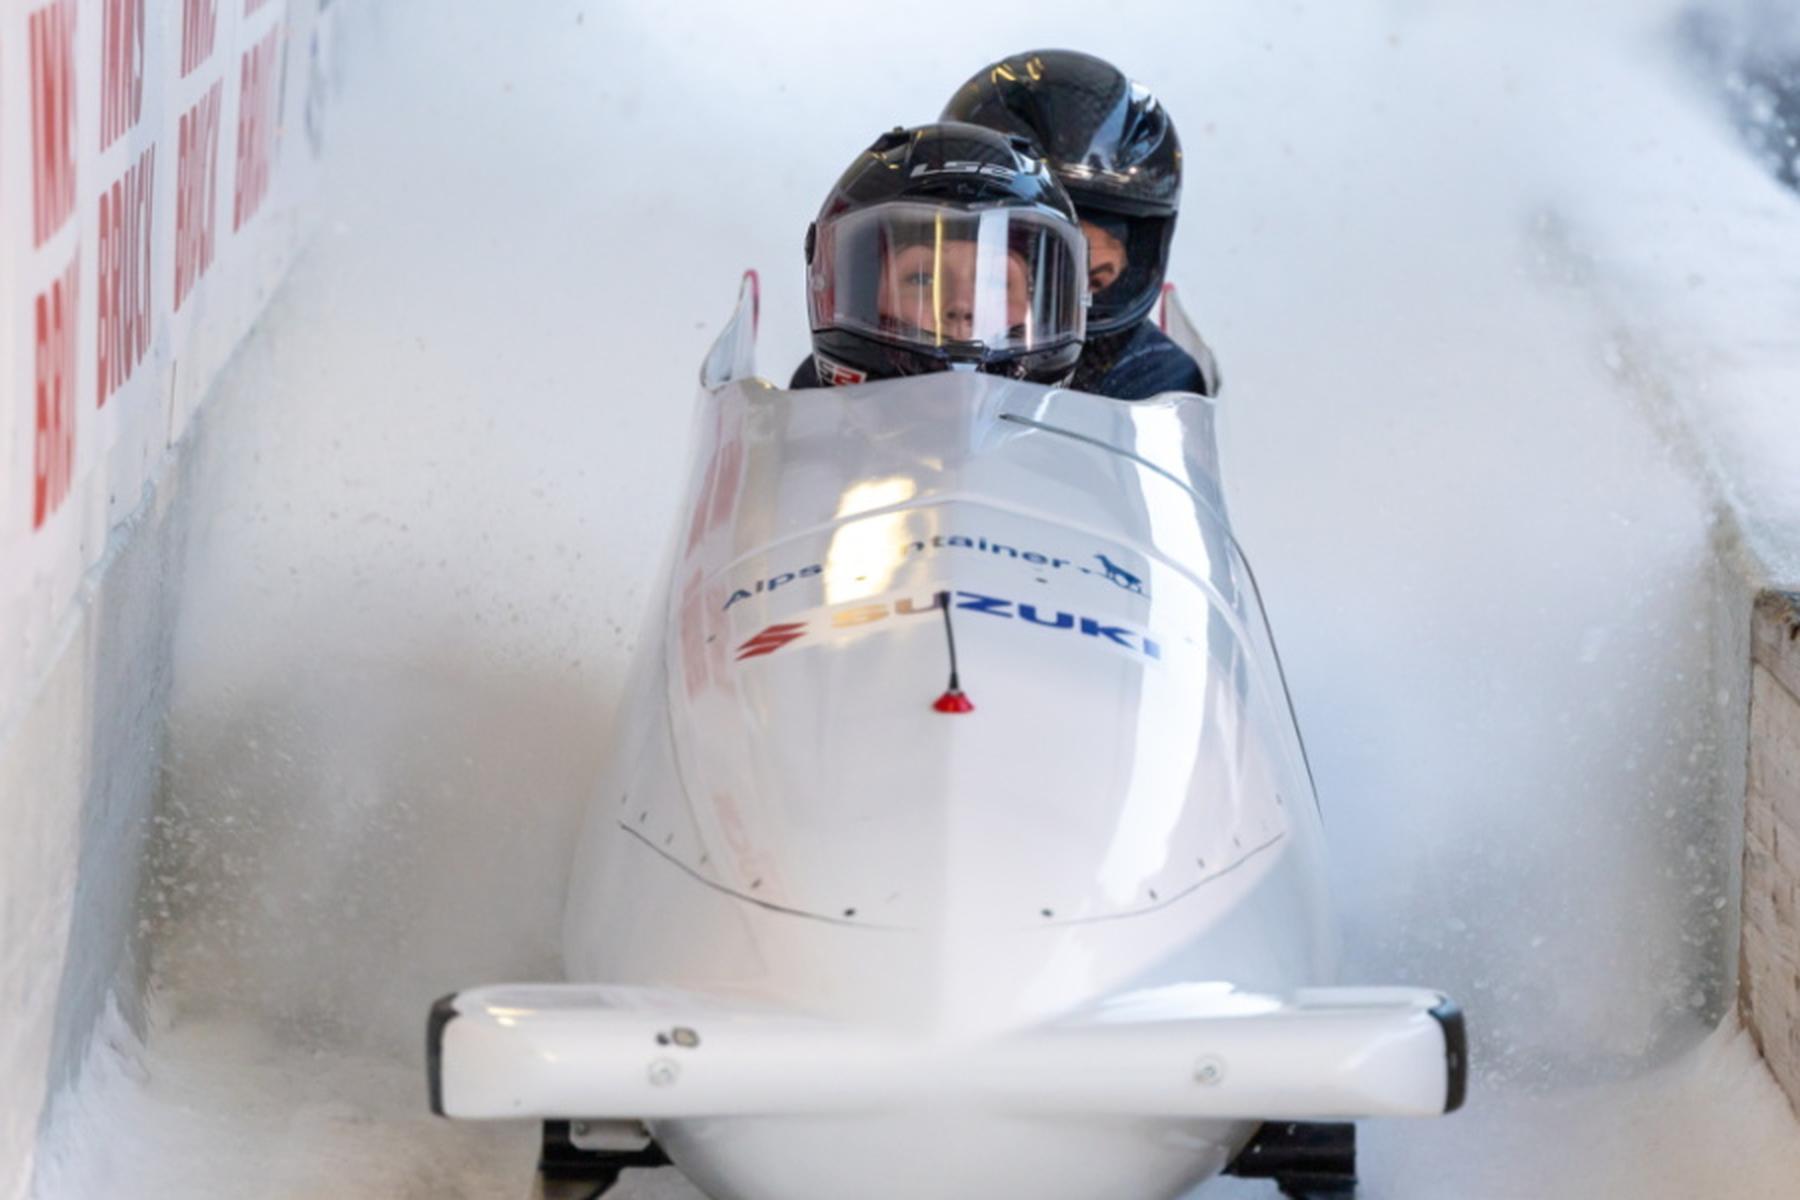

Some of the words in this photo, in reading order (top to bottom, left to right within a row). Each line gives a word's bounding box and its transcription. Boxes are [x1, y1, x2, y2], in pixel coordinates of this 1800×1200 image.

[96, 140, 156, 411] BRUCK
[722, 563, 822, 611] Alps
[902, 534, 1071, 569] ntainer
[832, 590, 1160, 660] SUZUKI
